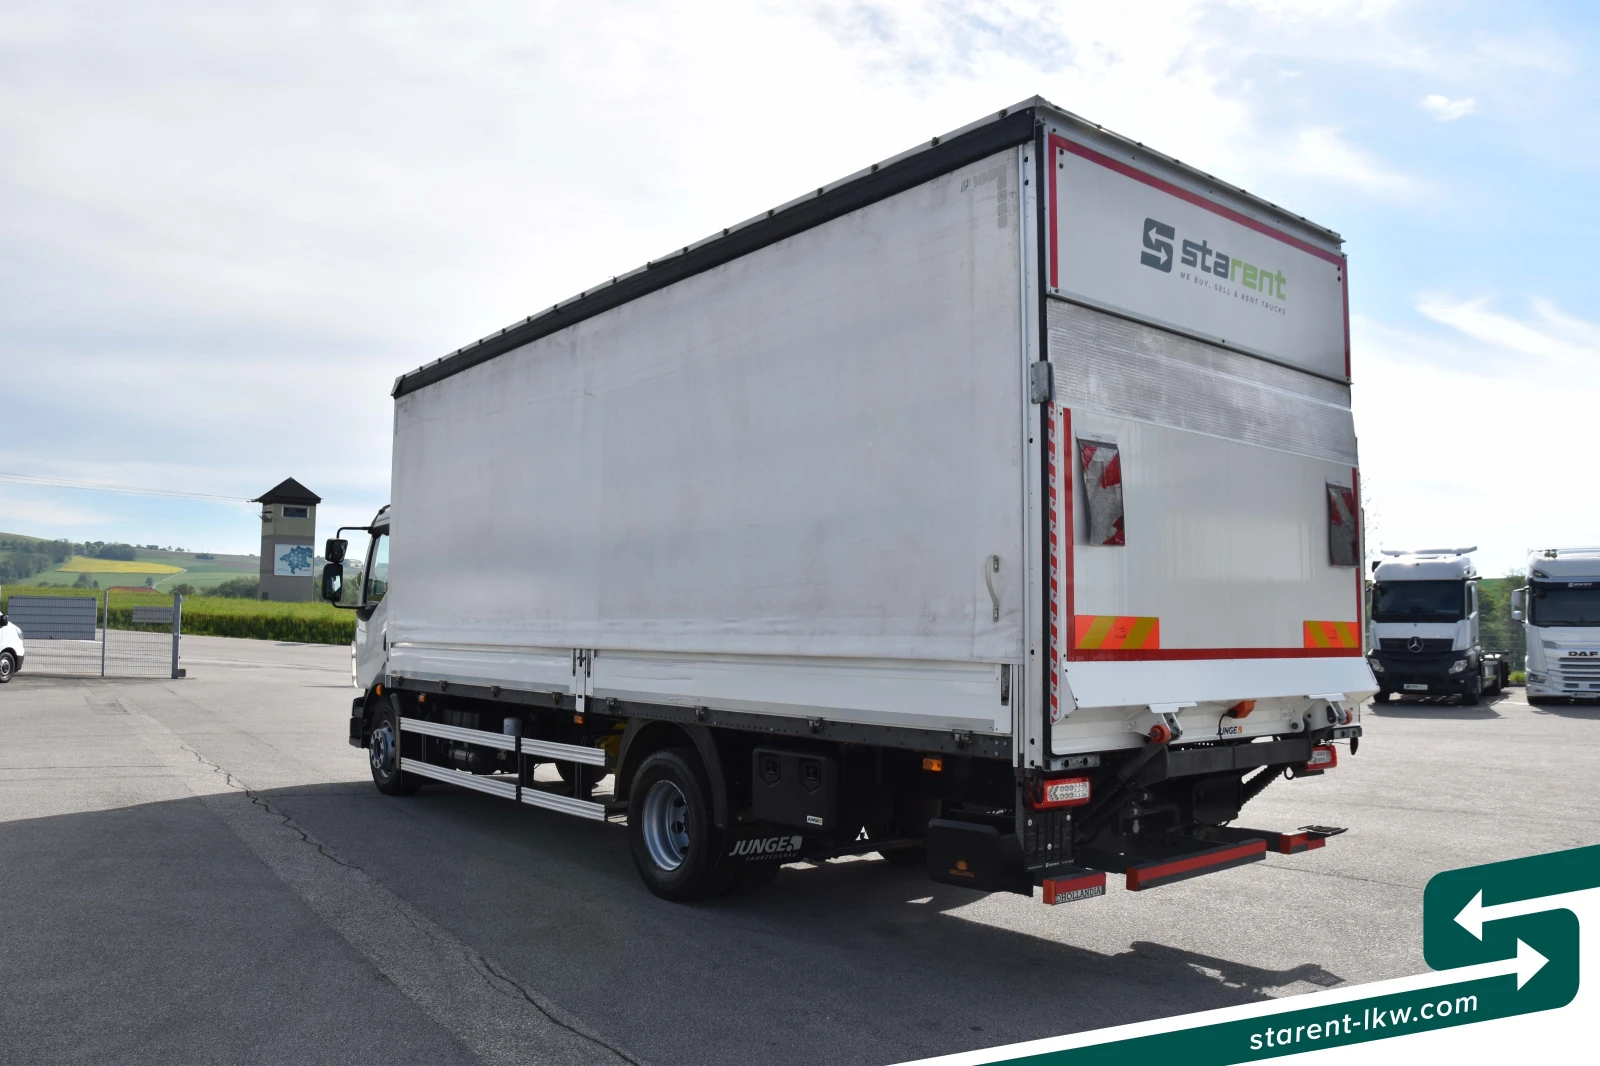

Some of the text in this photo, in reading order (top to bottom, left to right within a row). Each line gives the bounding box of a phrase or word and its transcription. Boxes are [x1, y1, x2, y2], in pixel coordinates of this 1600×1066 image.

[1181, 239, 1286, 301] starent
[1180, 271, 1287, 316] WE BUY, SELL & RENT TRUCKS
[728, 836, 790, 857] JUNGE
[1056, 886, 1102, 903] DHOLLANDIA
